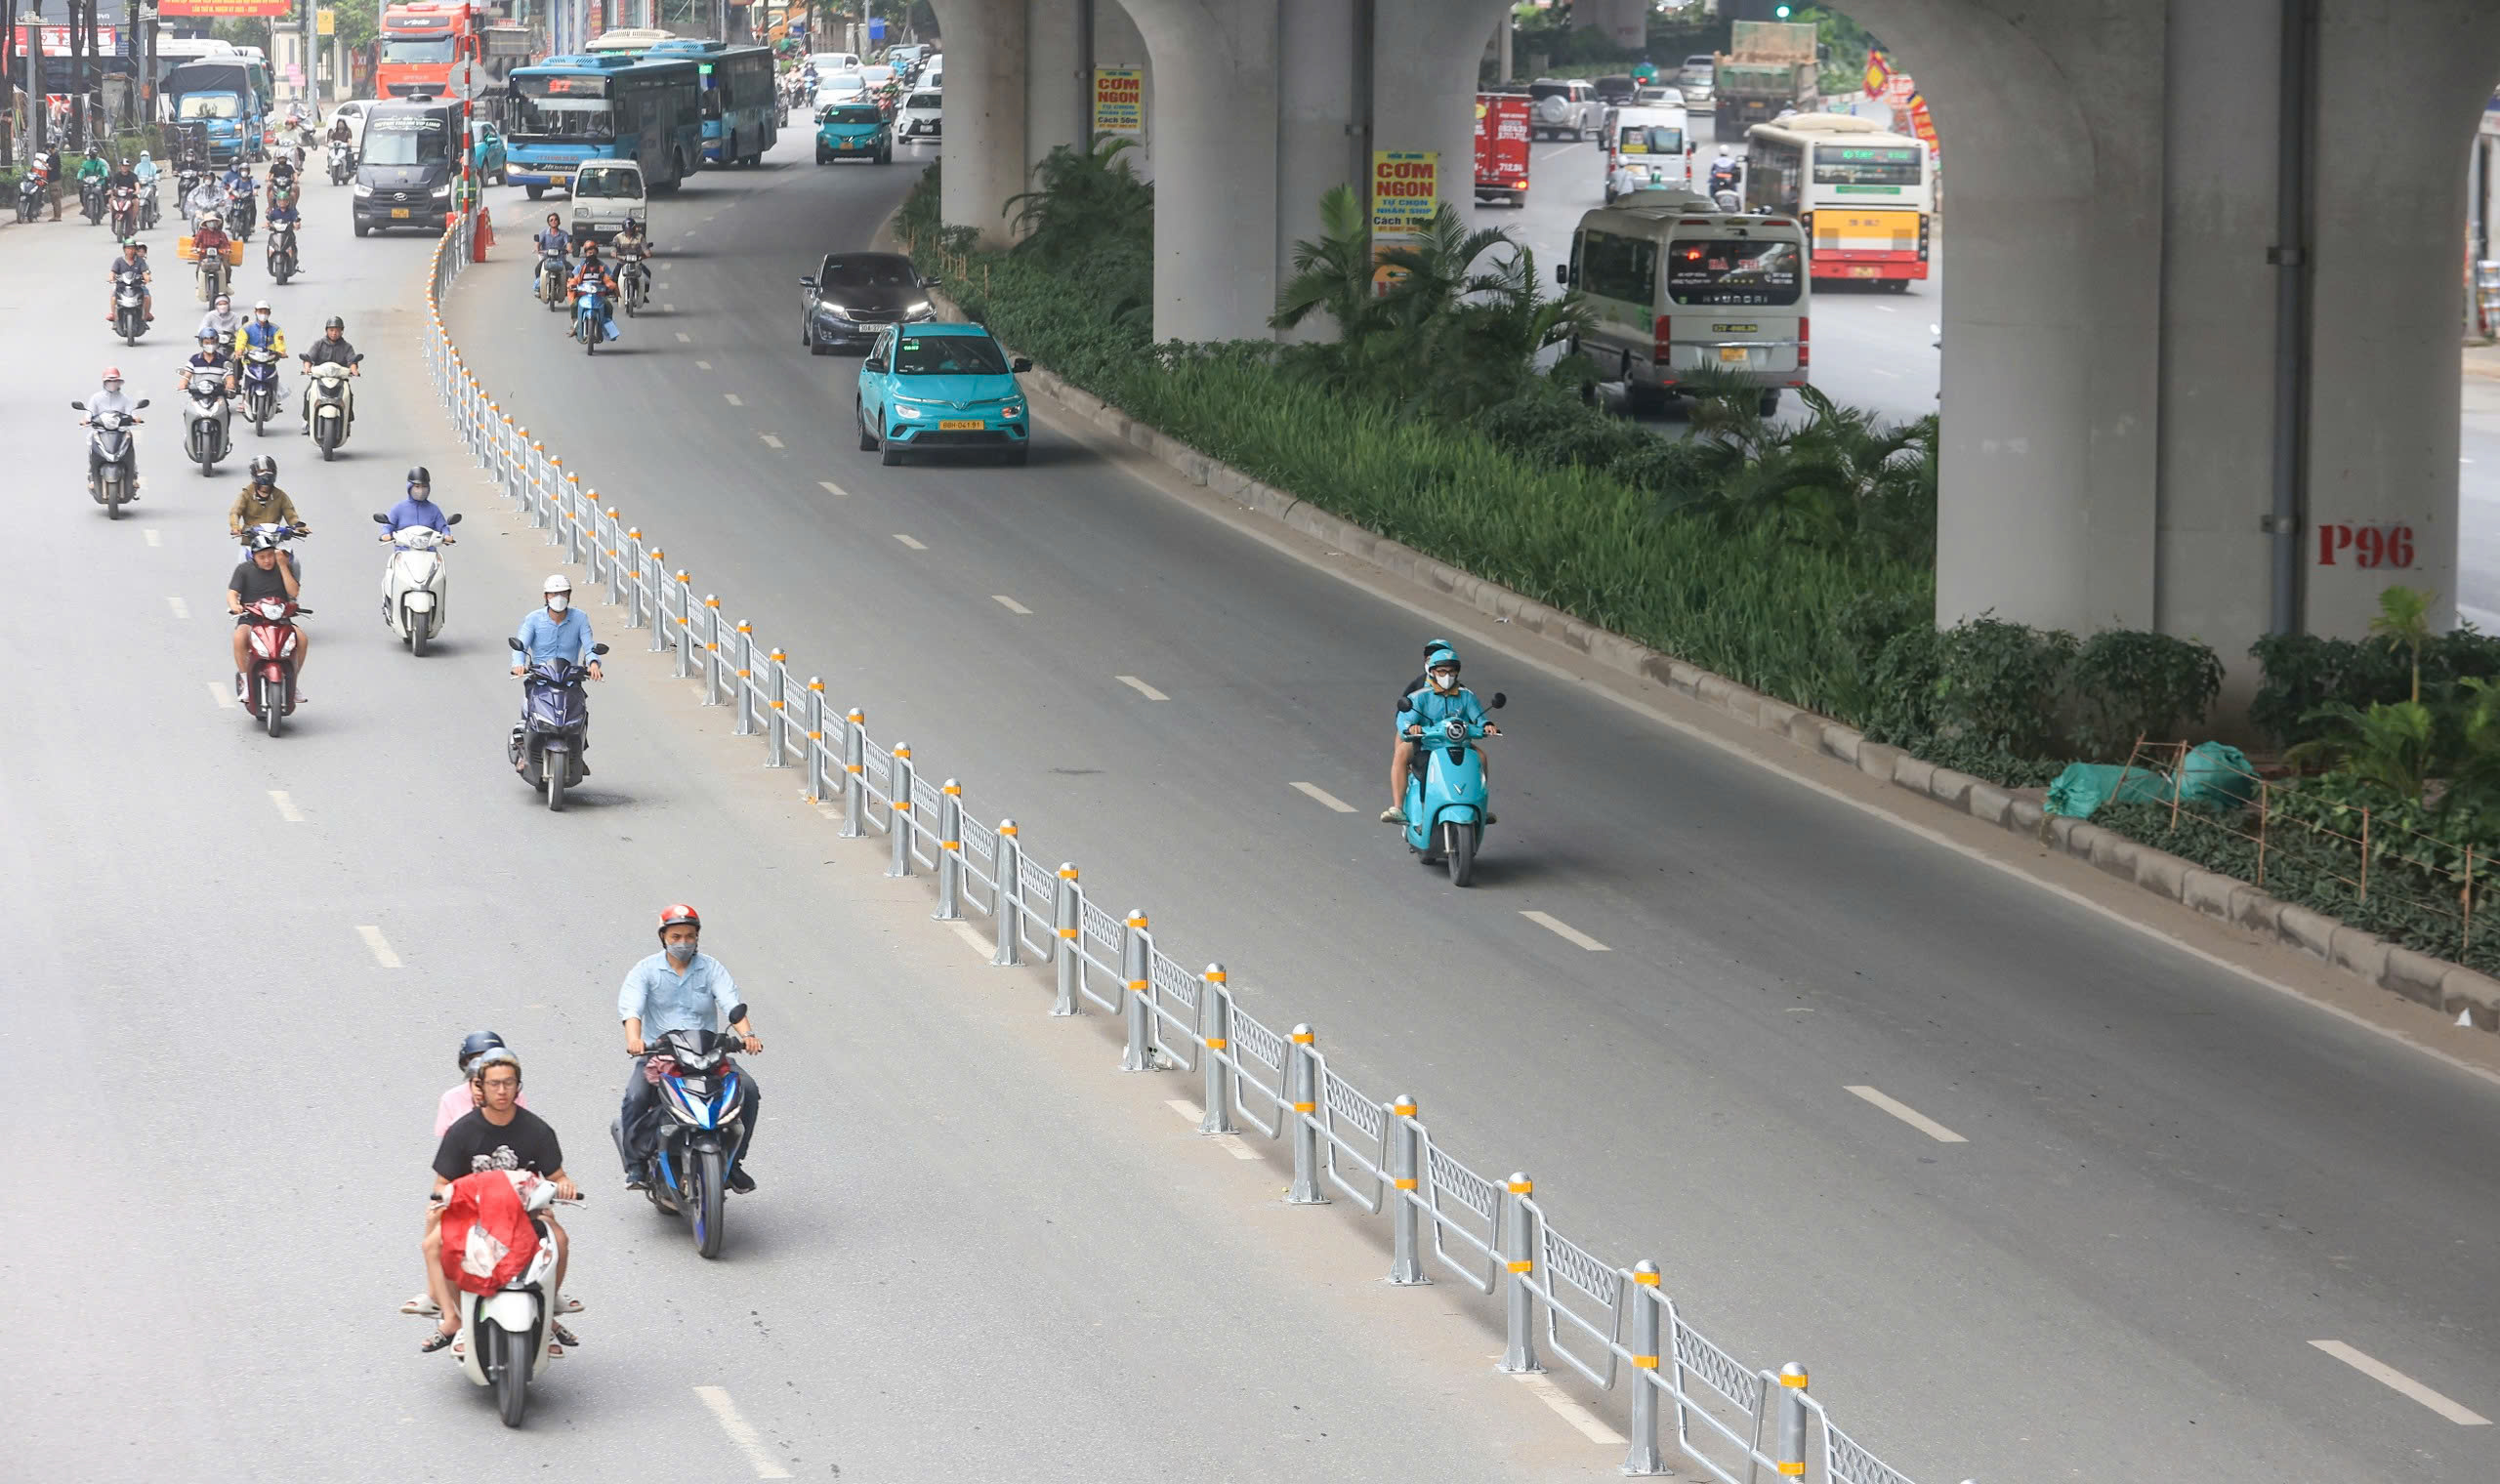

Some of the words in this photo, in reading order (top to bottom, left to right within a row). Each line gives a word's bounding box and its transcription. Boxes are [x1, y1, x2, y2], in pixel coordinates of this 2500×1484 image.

[1098, 78, 1140, 90] CƠM
[1098, 92, 1139, 103] NGON
[1377, 162, 1434, 179] CƠM
[1376, 181, 1434, 197] NGON
[1373, 216, 1401, 226] Cách
[2316, 524, 2415, 568] P96
